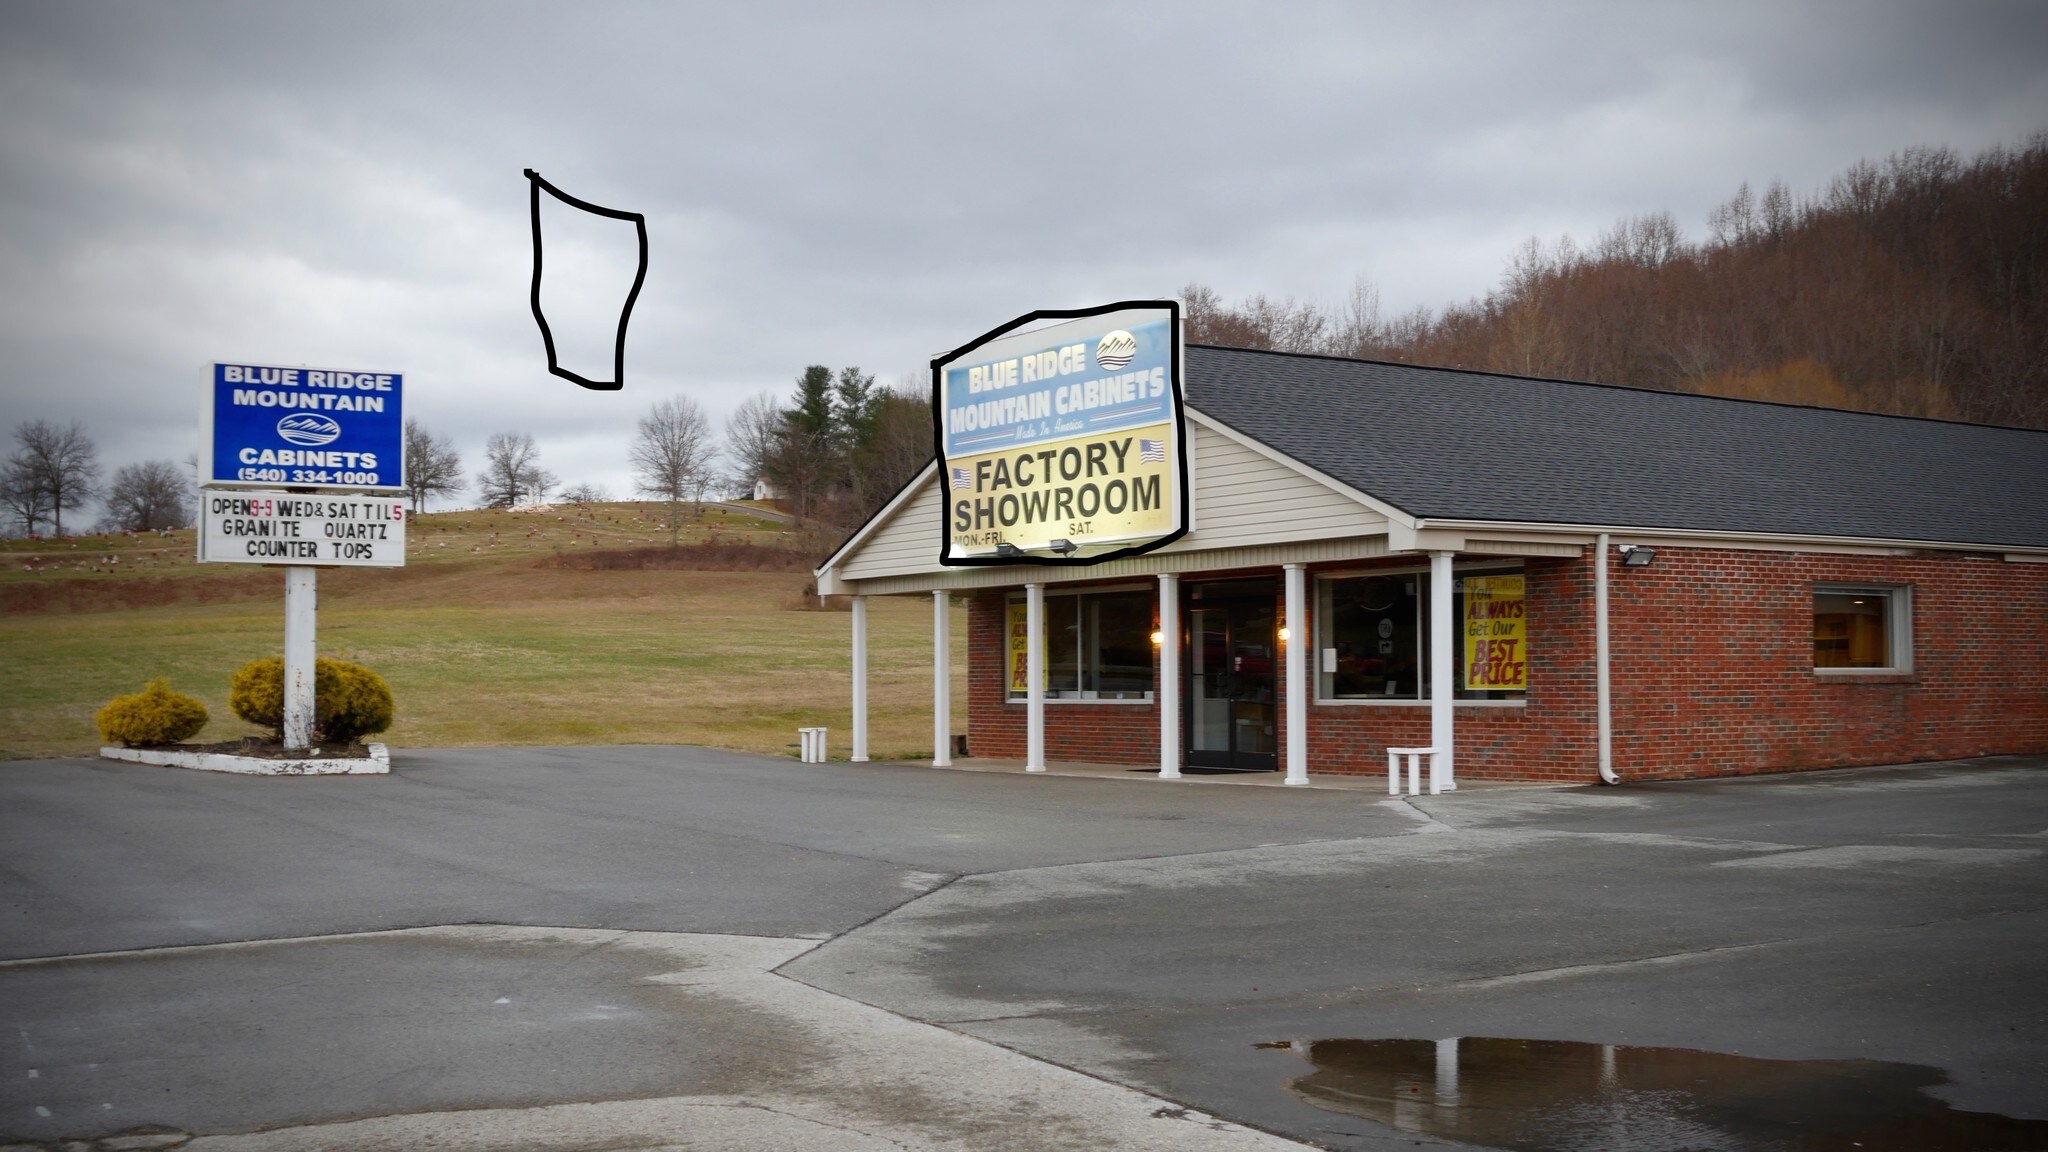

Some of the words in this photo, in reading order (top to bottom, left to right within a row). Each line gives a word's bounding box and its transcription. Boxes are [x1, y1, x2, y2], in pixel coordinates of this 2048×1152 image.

[224, 366, 299, 386] BLUE
[307, 371, 393, 392] RIDGE
[969, 358, 1018, 394] BLUE
[1022, 343, 1087, 384] RIDGE
[233, 389, 385, 413] MOUNTAIN
[950, 390, 1051, 434] MOUNTAIN
[1055, 366, 1165, 415] CABINETS
[1015, 423, 1037, 440] Made
[238, 447, 379, 469] CABINETS
[975, 437, 1133, 493] FACTORY
[238, 467, 287, 482] (540)
[292, 469, 379, 485] 334-1000
[954, 474, 1161, 532] SHOWROOM
[223, 519, 300, 537] GRANITE
[324, 522, 387, 540] QUARTZ
[1069, 521, 1094, 536] SAT.
[246, 540, 318, 558] COUNTER
[332, 542, 373, 559] TOPS
[1467, 600, 1524, 620] ALWAYS
[1469, 621, 1488, 637] Get
[1492, 621, 1516, 636] Our
[1475, 639, 1518, 662] BEST
[1469, 662, 1525, 685] PRICE
